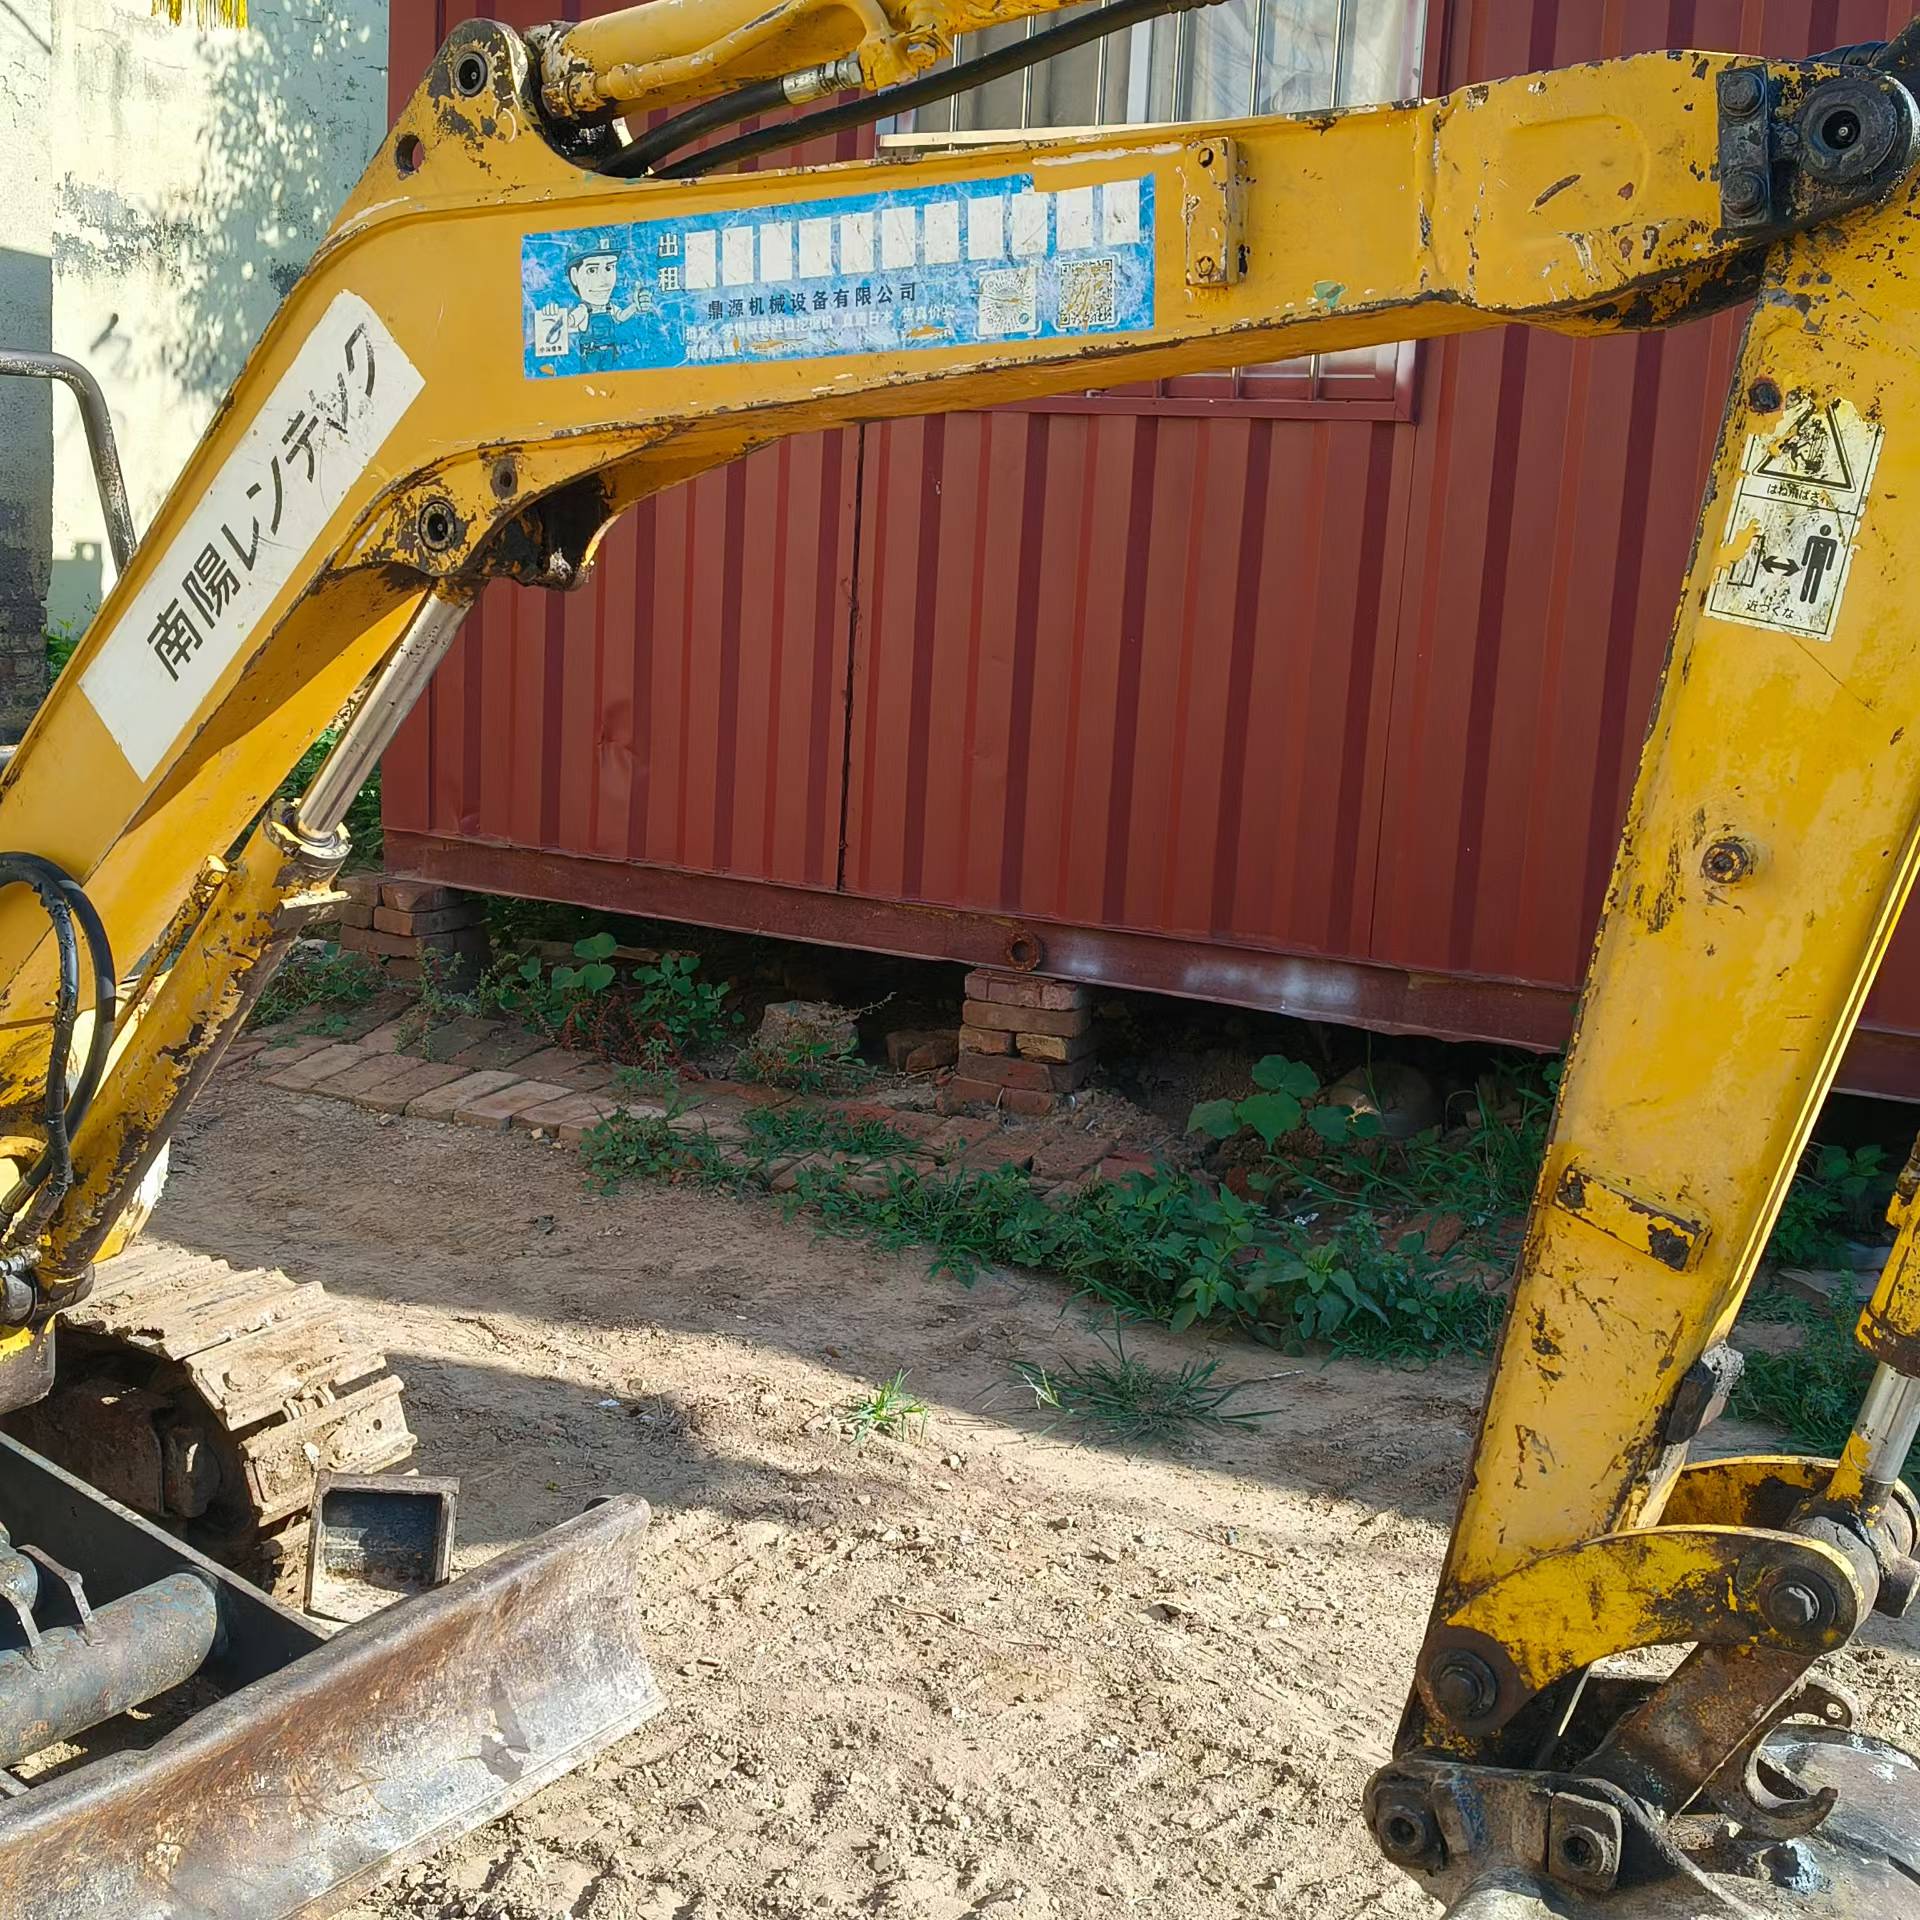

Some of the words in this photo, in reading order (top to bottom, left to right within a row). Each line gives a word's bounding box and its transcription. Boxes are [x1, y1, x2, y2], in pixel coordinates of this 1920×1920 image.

[658, 232, 680, 291] 出租
[708, 282, 916, 320] 鼎源机械设备有限公司
[1745, 599, 1794, 619] 近づくな
